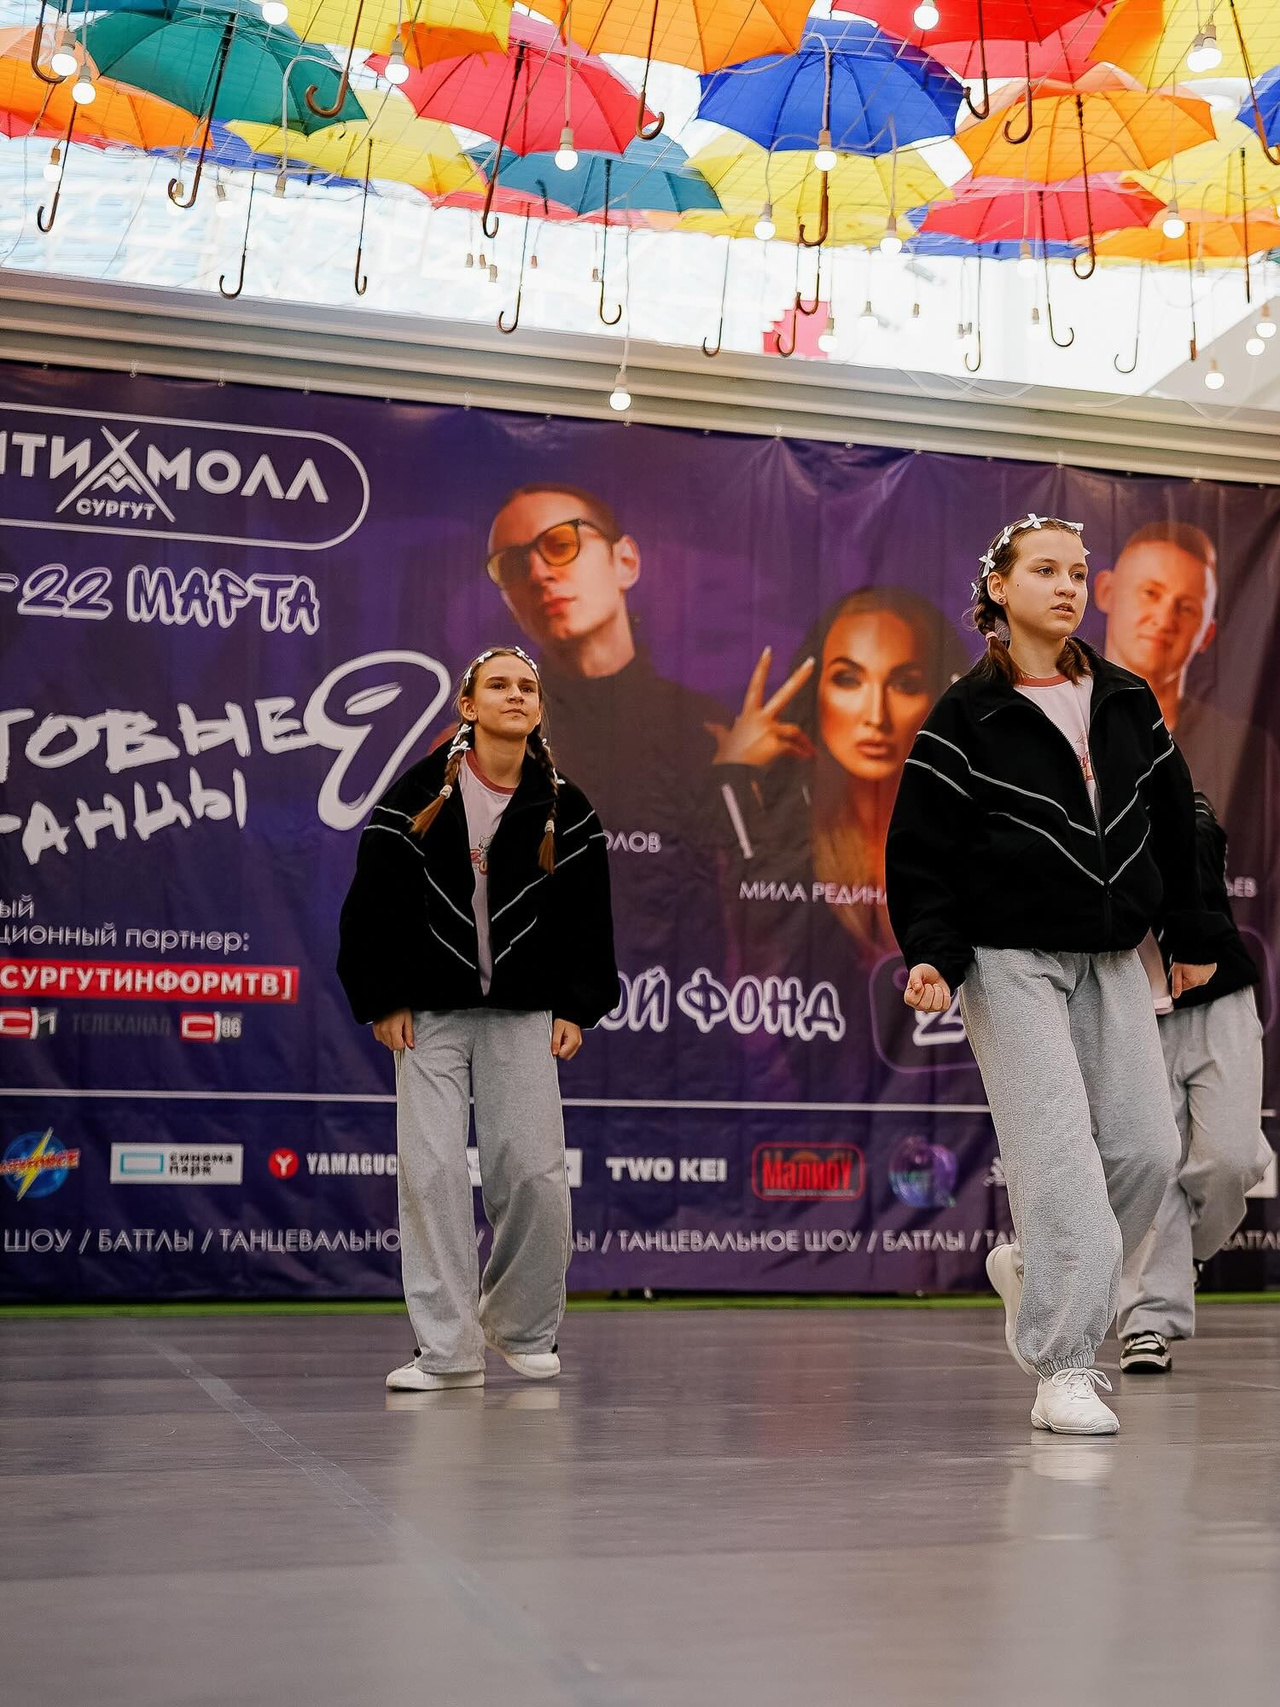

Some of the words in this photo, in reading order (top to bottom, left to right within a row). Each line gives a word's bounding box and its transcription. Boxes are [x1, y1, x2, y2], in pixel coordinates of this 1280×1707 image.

[147, 443, 329, 504] МОЛЛ
[76, 498, 157, 521] СУРГУТ
[126, 564, 320, 636] МАРТА
[739, 881, 808, 902] МИЛА
[125, 928, 250, 955] партнер:
[677, 967, 846, 1042] ФОНА
[606, 1157, 675, 1182] TWO
[679, 1158, 728, 1183] KEI
[4, 1228, 72, 1253] ШОУ
[100, 1228, 194, 1252] БАТТЛЫ
[617, 1228, 799, 1254] ТАНЦЕВАЛЬНОЕ
[804, 1229, 861, 1252] ШОУ
[882, 1229, 966, 1252] БАТТЛЫ
